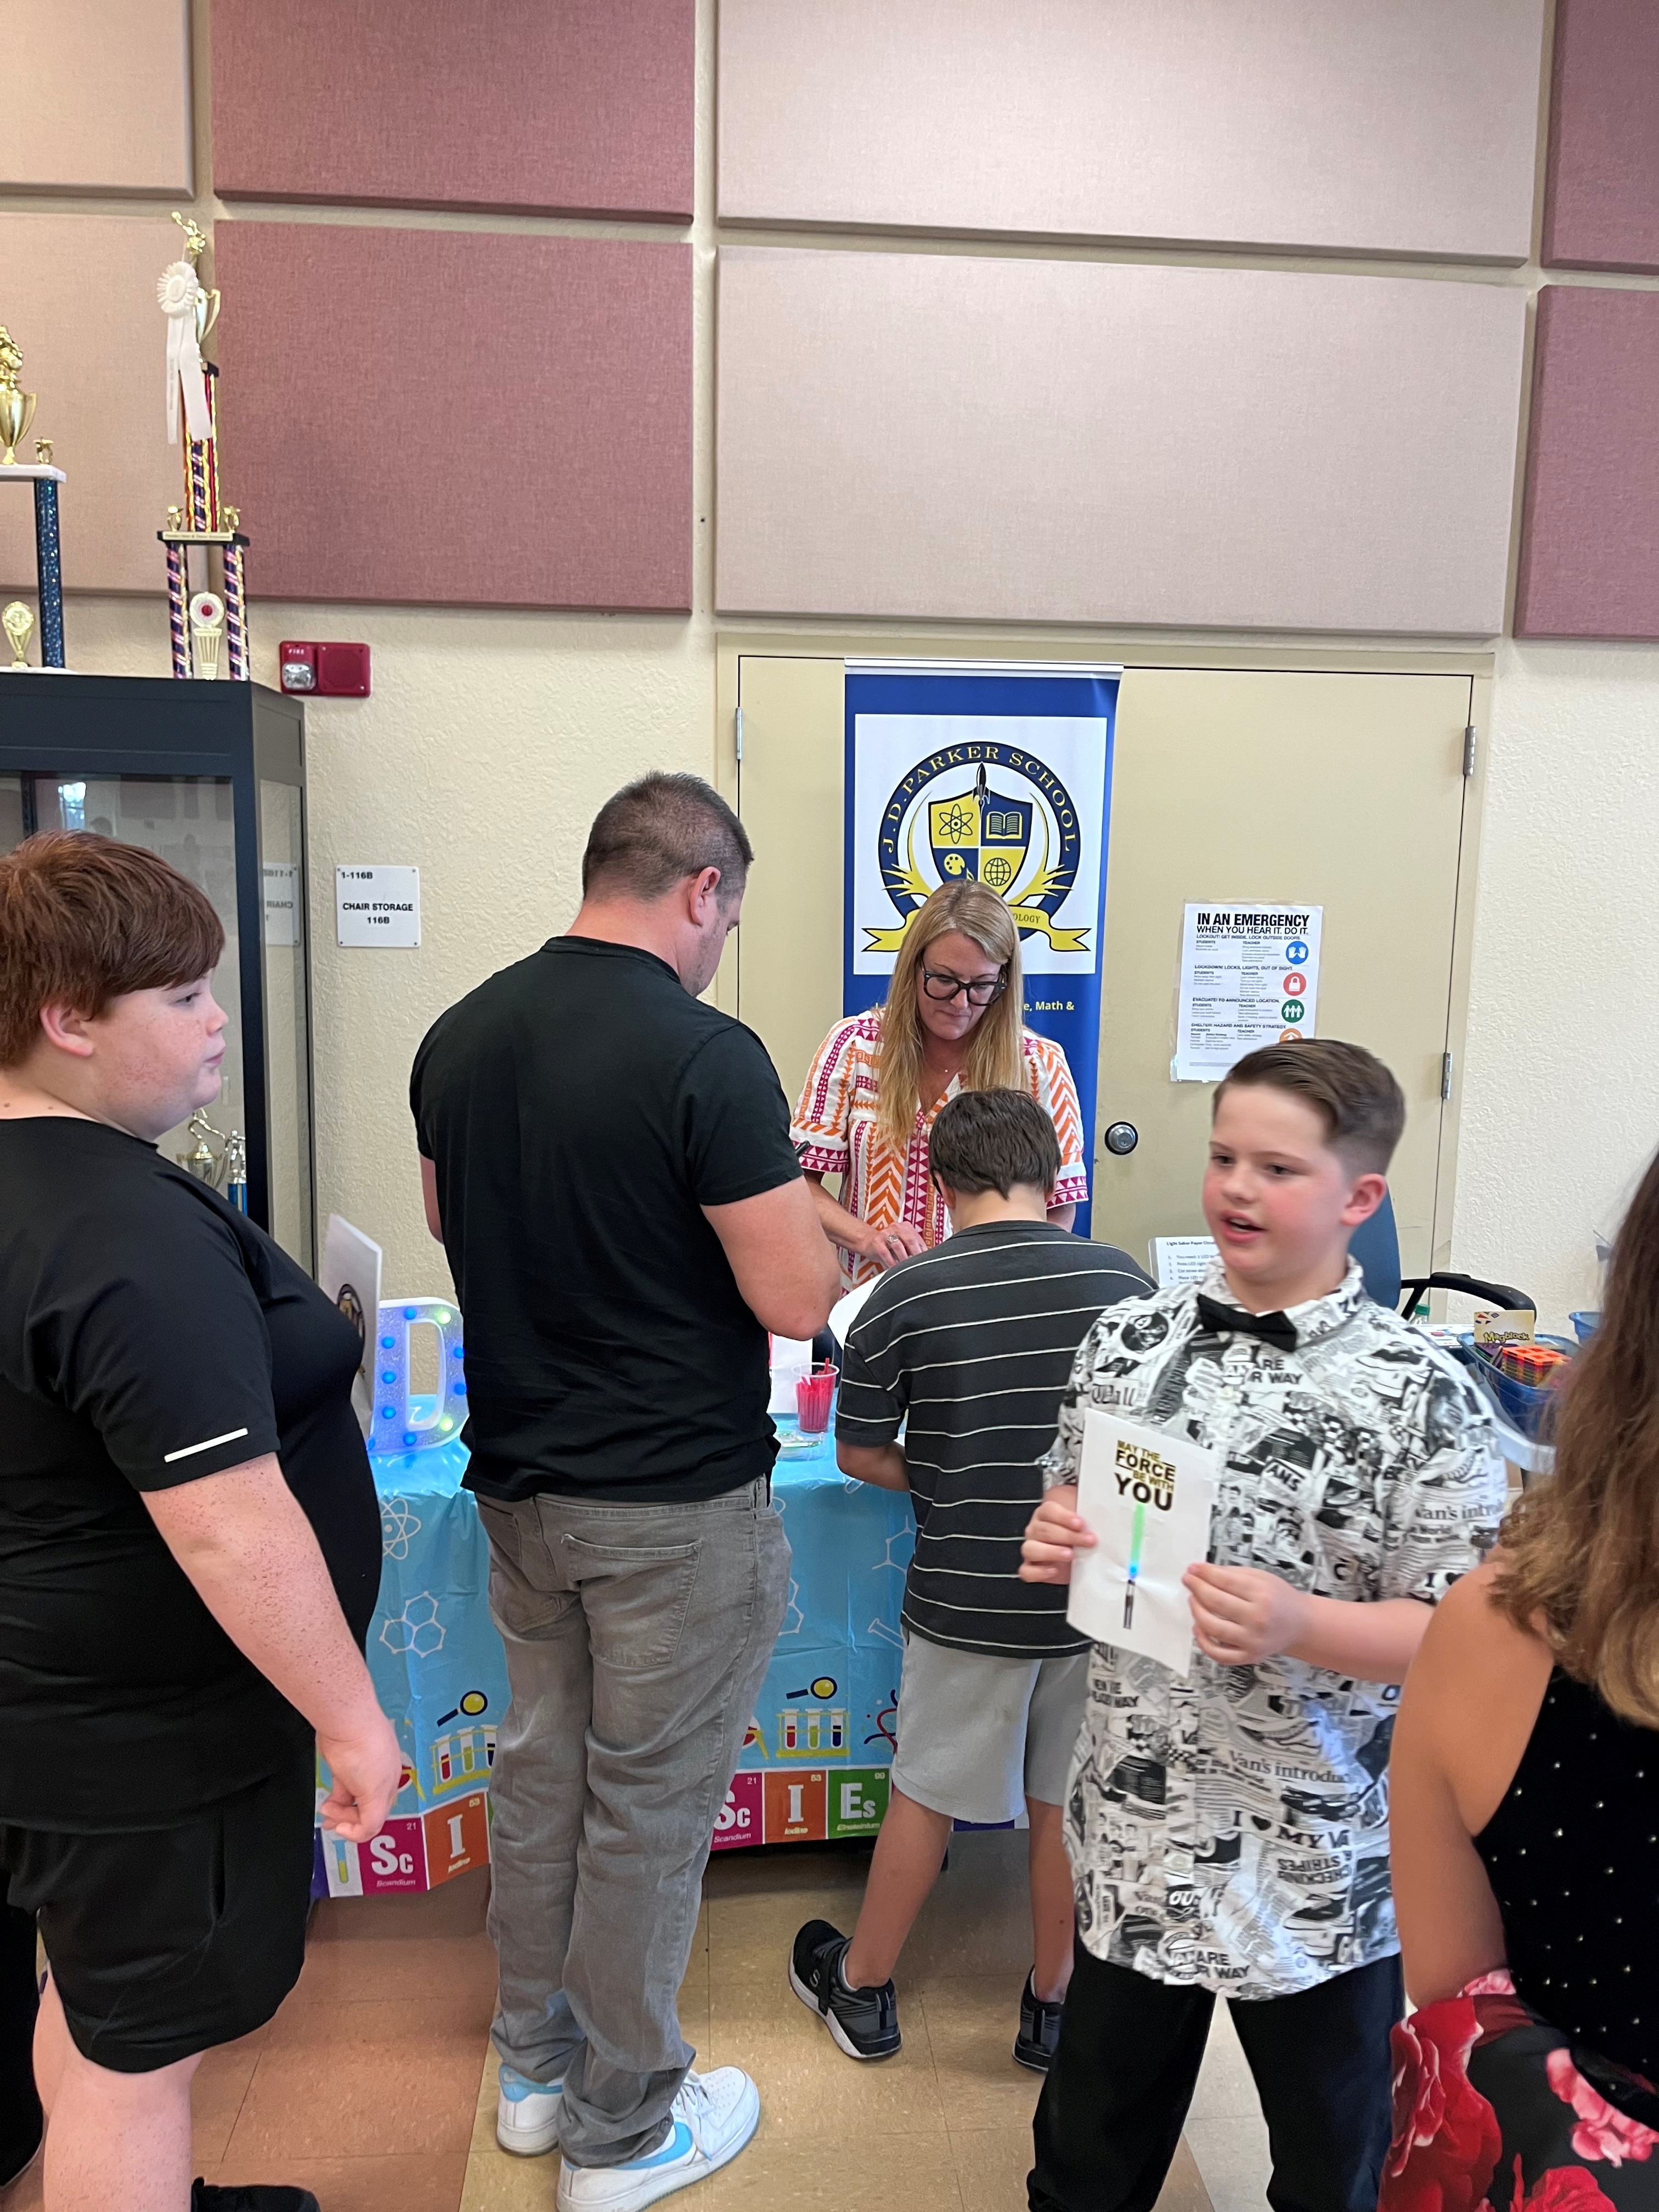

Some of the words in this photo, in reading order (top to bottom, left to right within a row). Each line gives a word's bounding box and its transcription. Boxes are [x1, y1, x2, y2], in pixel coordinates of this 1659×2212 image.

[1009, 752, 1076, 851] SCHOOL
[341, 871, 374, 879] 1-116B
[342, 902, 370, 911] CHAIR
[372, 903, 414, 911] STORAGE
[367, 916, 390, 924] 116B
[1013, 913, 1041, 924] OLOGY
[1197, 913, 1210, 925] IN
[1213, 913, 1231, 926] AN
[1234, 913, 1311, 927] EMERGENCY
[1197, 926, 1224, 934] WHEN
[1035, 1000, 1064, 1011] Math
[1065, 1001, 1075, 1011] &
[1483, 1331, 1530, 1343] Magblock
[1117, 1440, 1139, 1454] MAY
[1141, 1447, 1161, 1460] THE
[1116, 1449, 1176, 1483] FORCE
[1132, 1470, 1146, 1482] BE
[1148, 1476, 1174, 1492] WITH
[1114, 1472, 1173, 1511] YOU
[788, 1784, 804, 1823] I
[840, 1782, 876, 1819] Es
[406, 1822, 417, 1831] 21
[714, 1833, 752, 1843] Scandium
[369, 1835, 414, 1876] Sc
